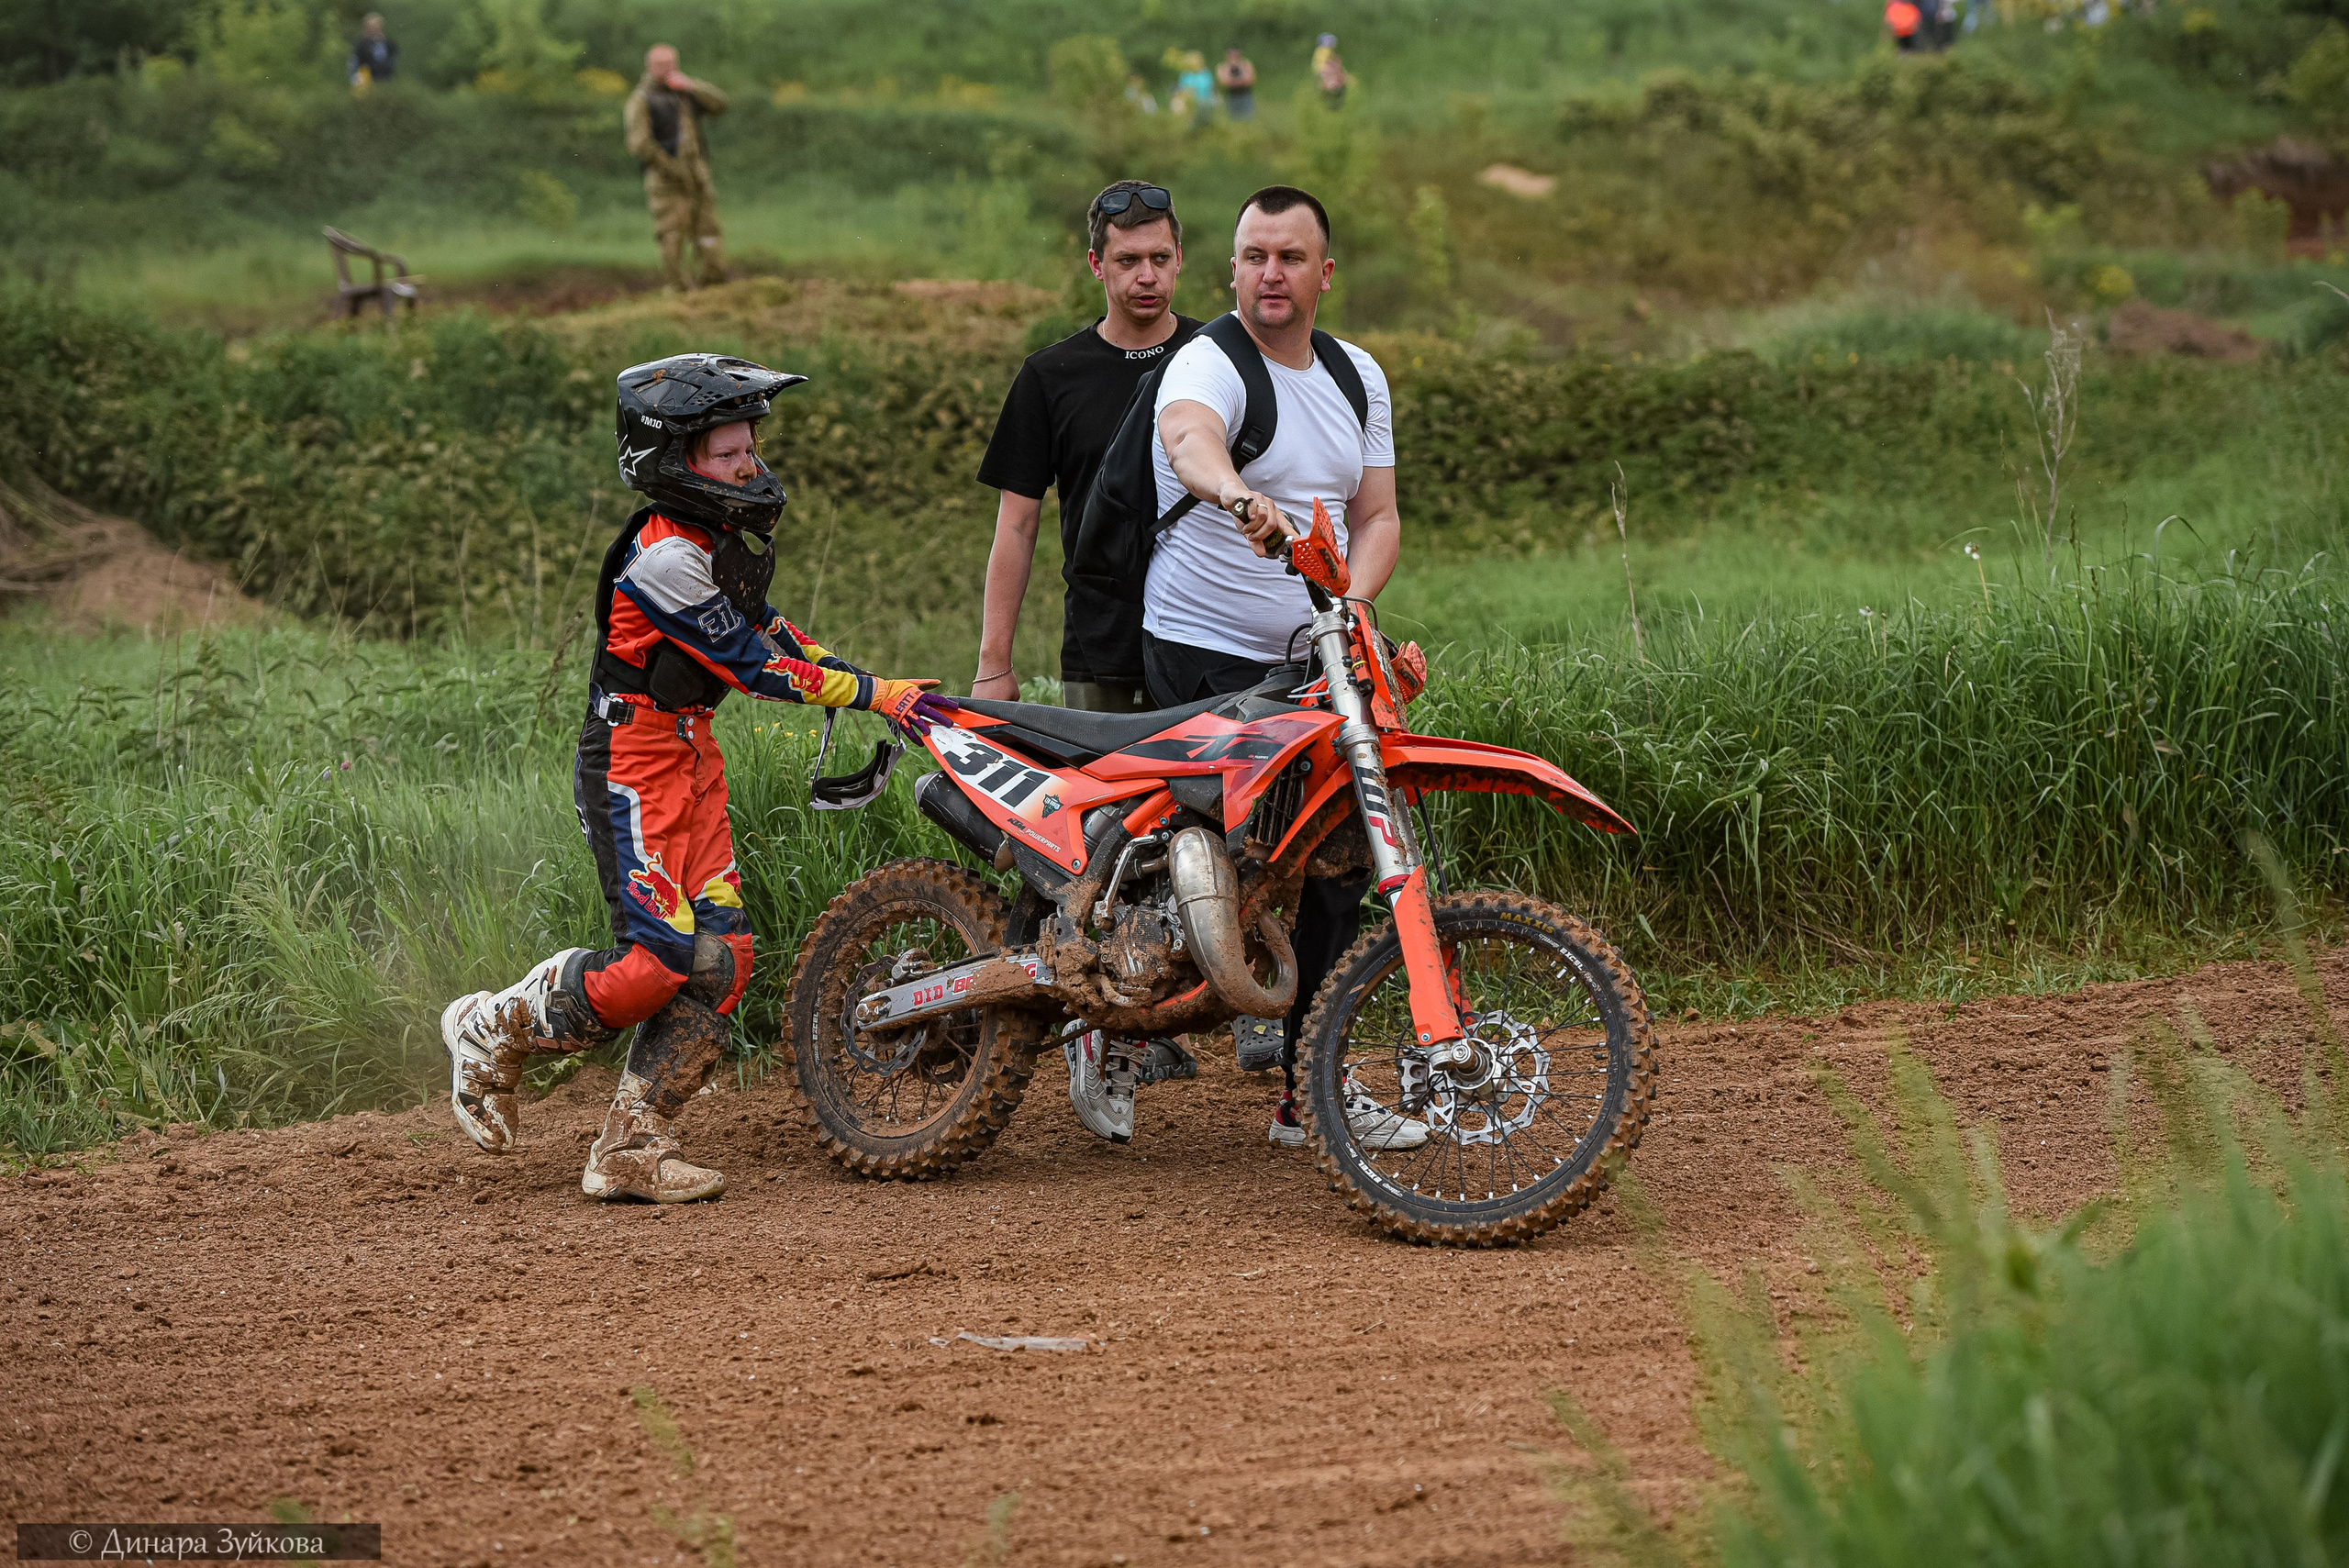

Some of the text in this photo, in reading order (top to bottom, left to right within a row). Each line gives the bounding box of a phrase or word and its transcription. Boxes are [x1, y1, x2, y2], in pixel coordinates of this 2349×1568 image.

[1125, 346, 1164, 359] ICONO
[892, 693, 915, 718] LEATT
[942, 742, 1051, 808] 311
[1025, 828, 1062, 853] POWERPARTS
[627, 881, 668, 920] Red Bull
[1499, 912, 1554, 934] MAXXIS
[1559, 947, 1584, 971] EXCEL
[1358, 1159, 1382, 1184] EXCEL
